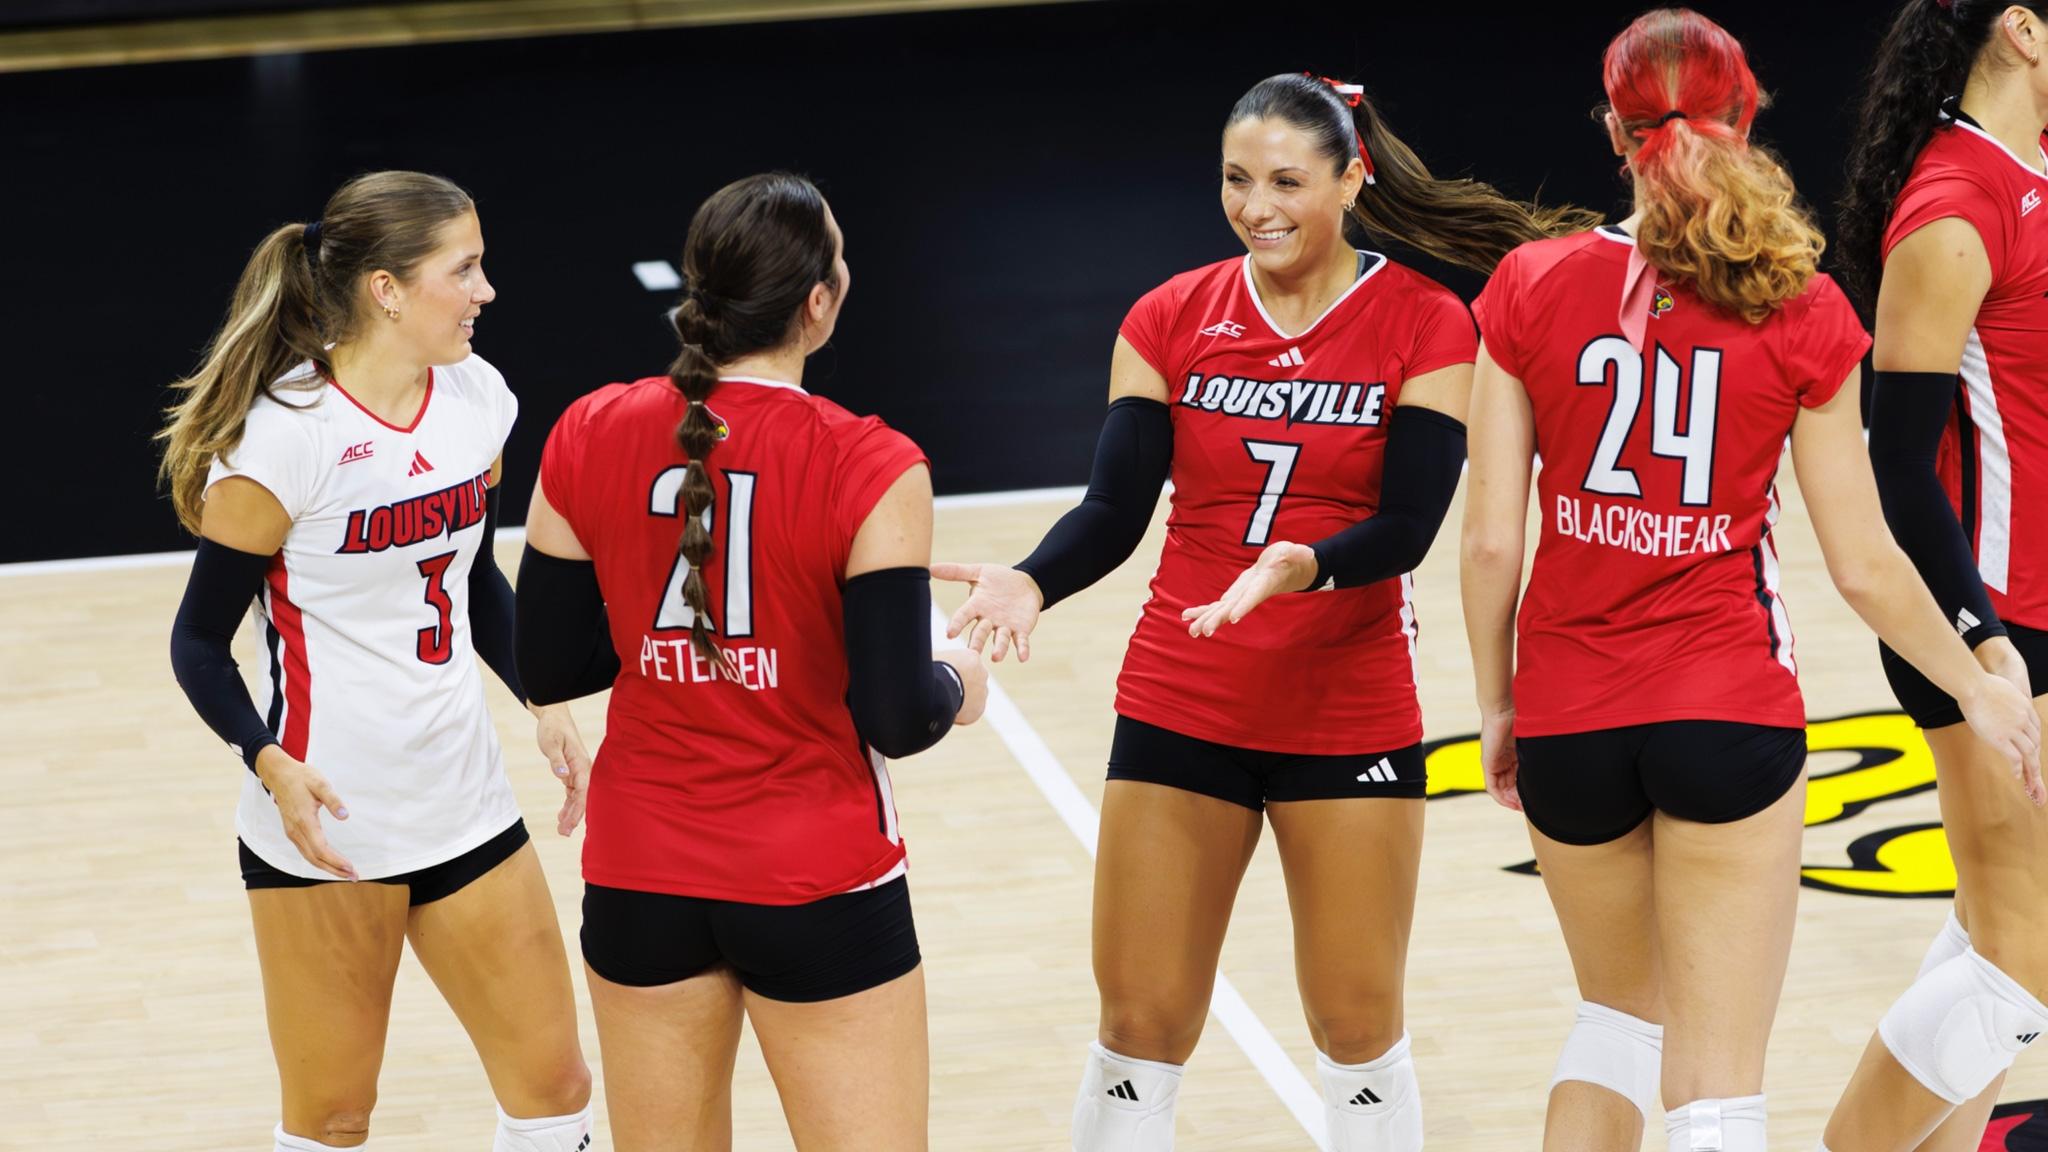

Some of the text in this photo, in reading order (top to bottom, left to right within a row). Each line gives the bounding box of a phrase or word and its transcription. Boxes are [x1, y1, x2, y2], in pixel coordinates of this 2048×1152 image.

[2021, 188, 2042, 217] ACC
[1181, 373, 1387, 430] LOUISVILLE
[1576, 333, 1724, 507] 24
[338, 441, 374, 465] ACC
[1241, 437, 1303, 547] 7
[648, 464, 758, 638] 21
[1556, 494, 1732, 557] BLACKSHEAR
[415, 549, 459, 666] 3
